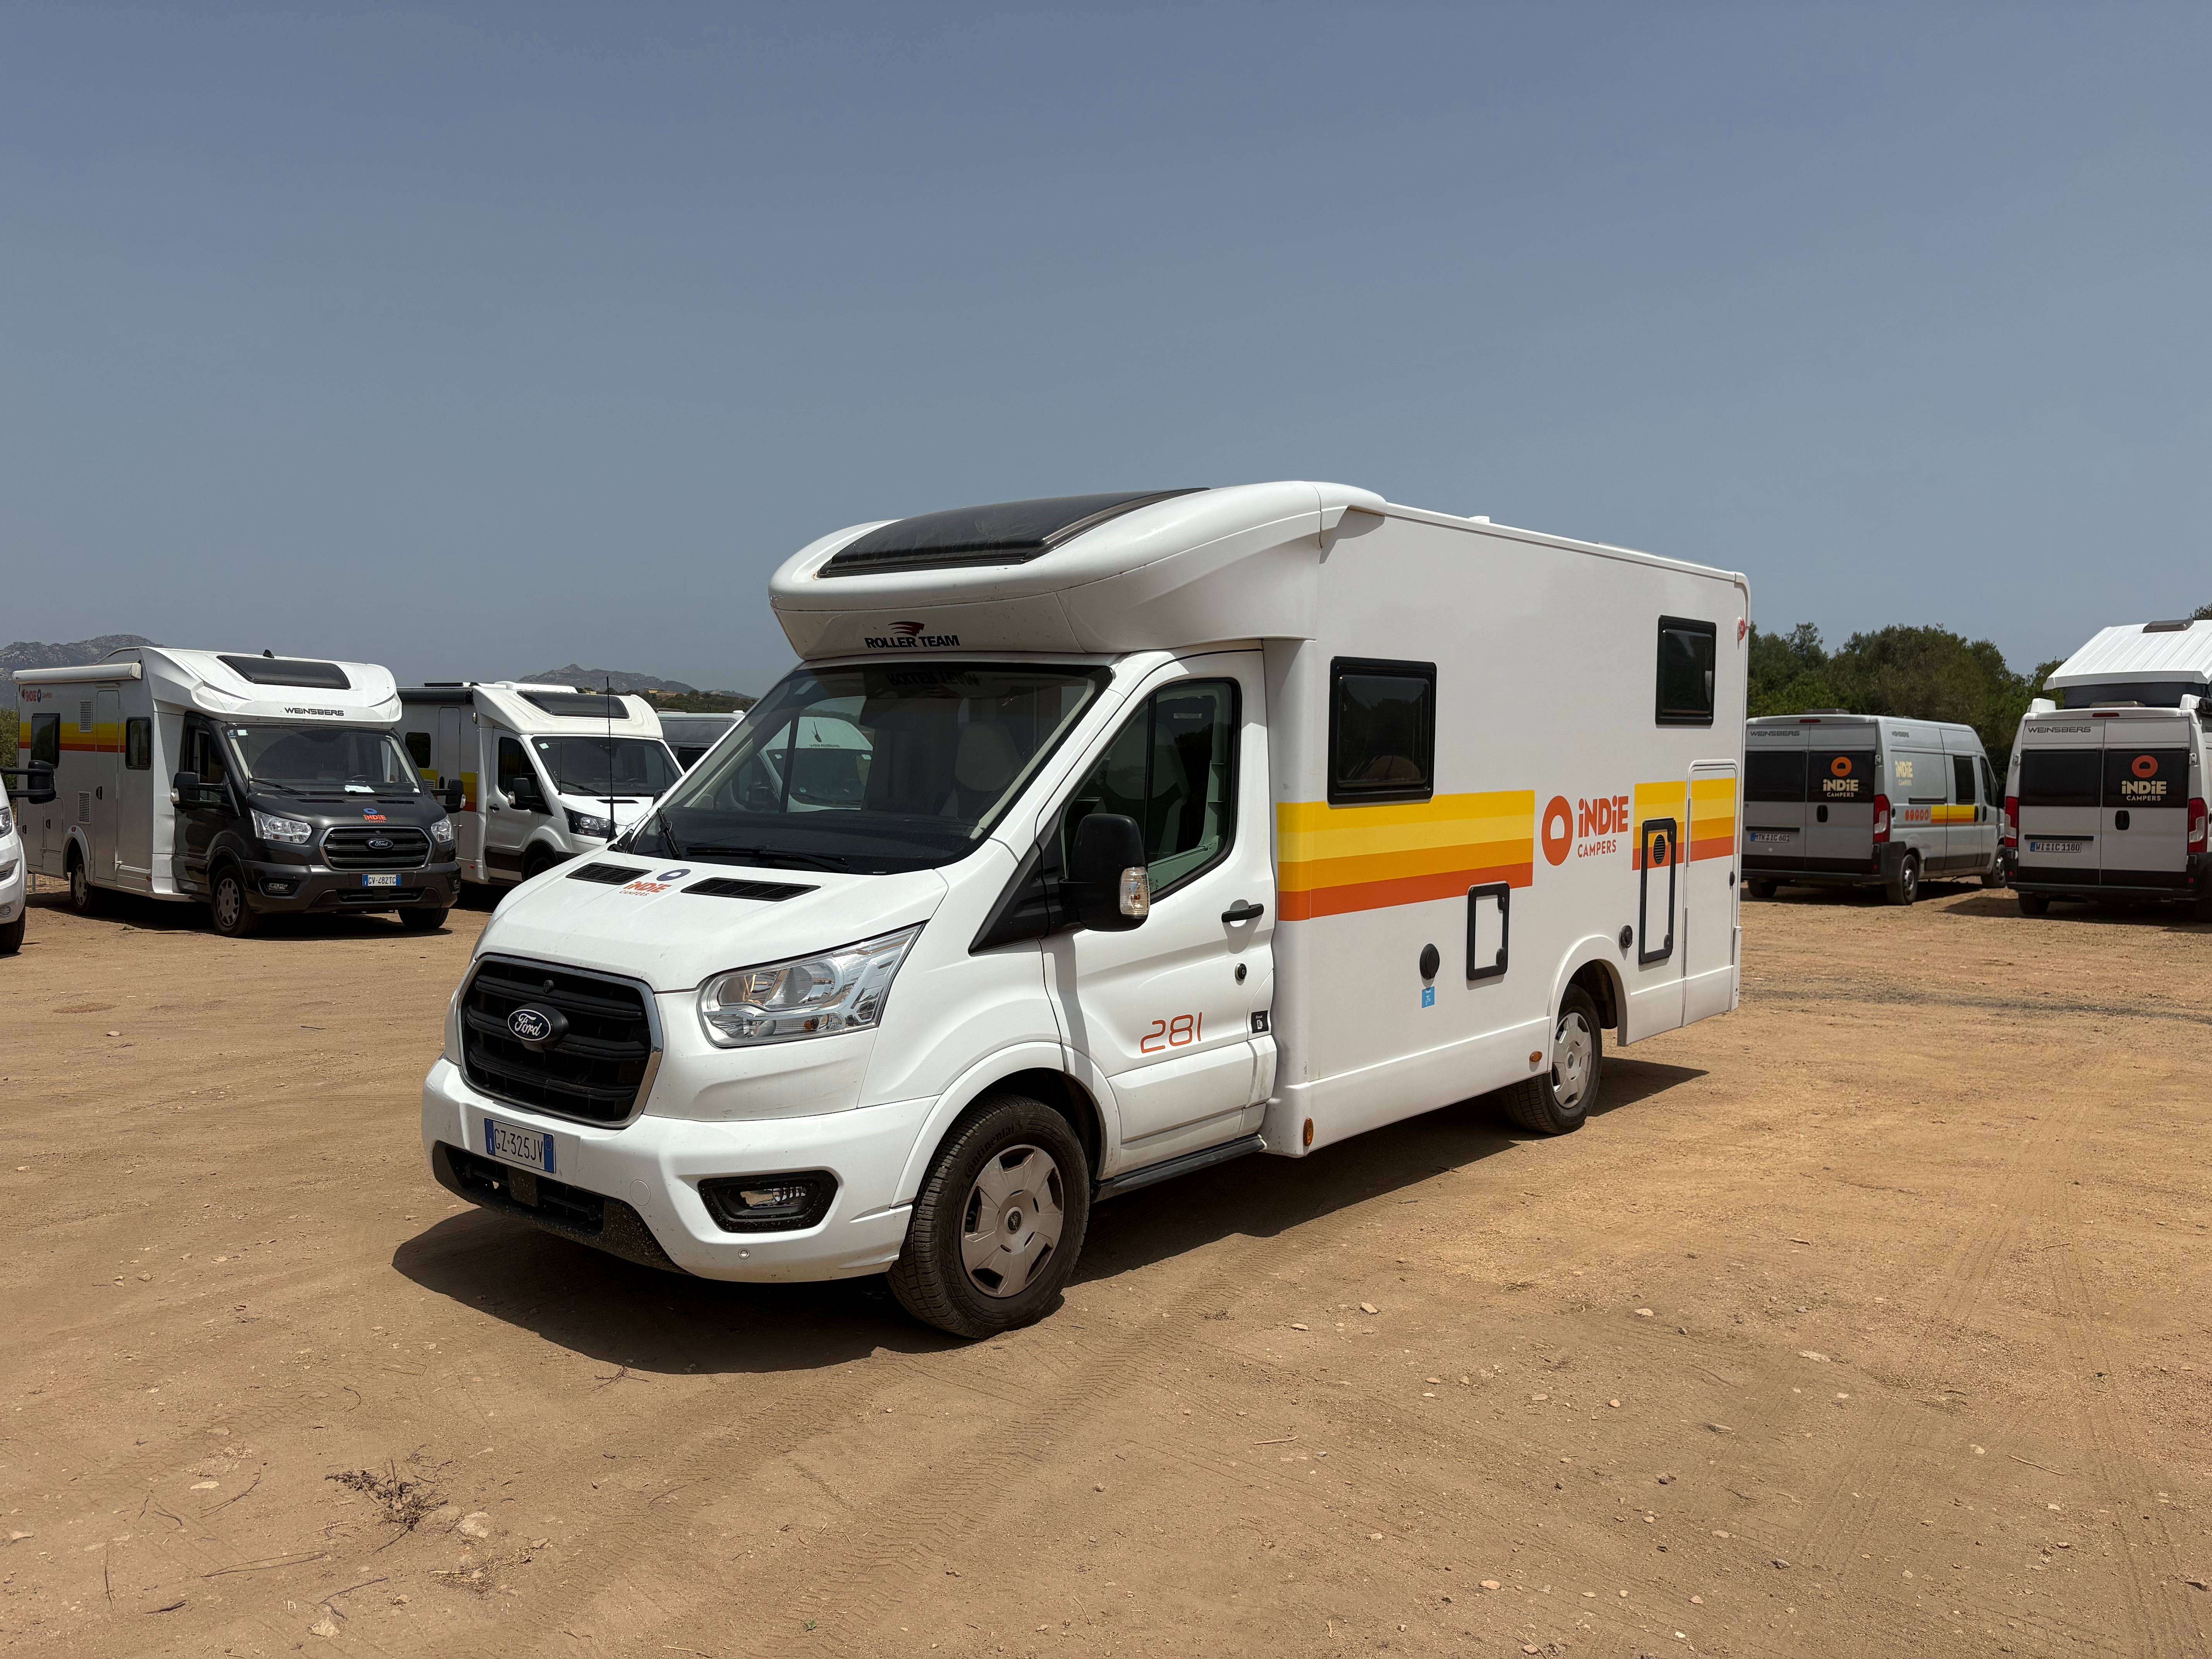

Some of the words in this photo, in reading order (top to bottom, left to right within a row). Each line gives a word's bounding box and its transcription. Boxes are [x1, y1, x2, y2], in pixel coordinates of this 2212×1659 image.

[864, 637, 918, 648] ROLLER
[918, 635, 960, 647] TEAM
[284, 708, 344, 716] WEINSBERG
[1578, 839, 1616, 858] CAMPERS
[515, 1013, 542, 1036] Ford
[1140, 1012, 1202, 1053] 281
[964, 1123, 1015, 1178] Continental
